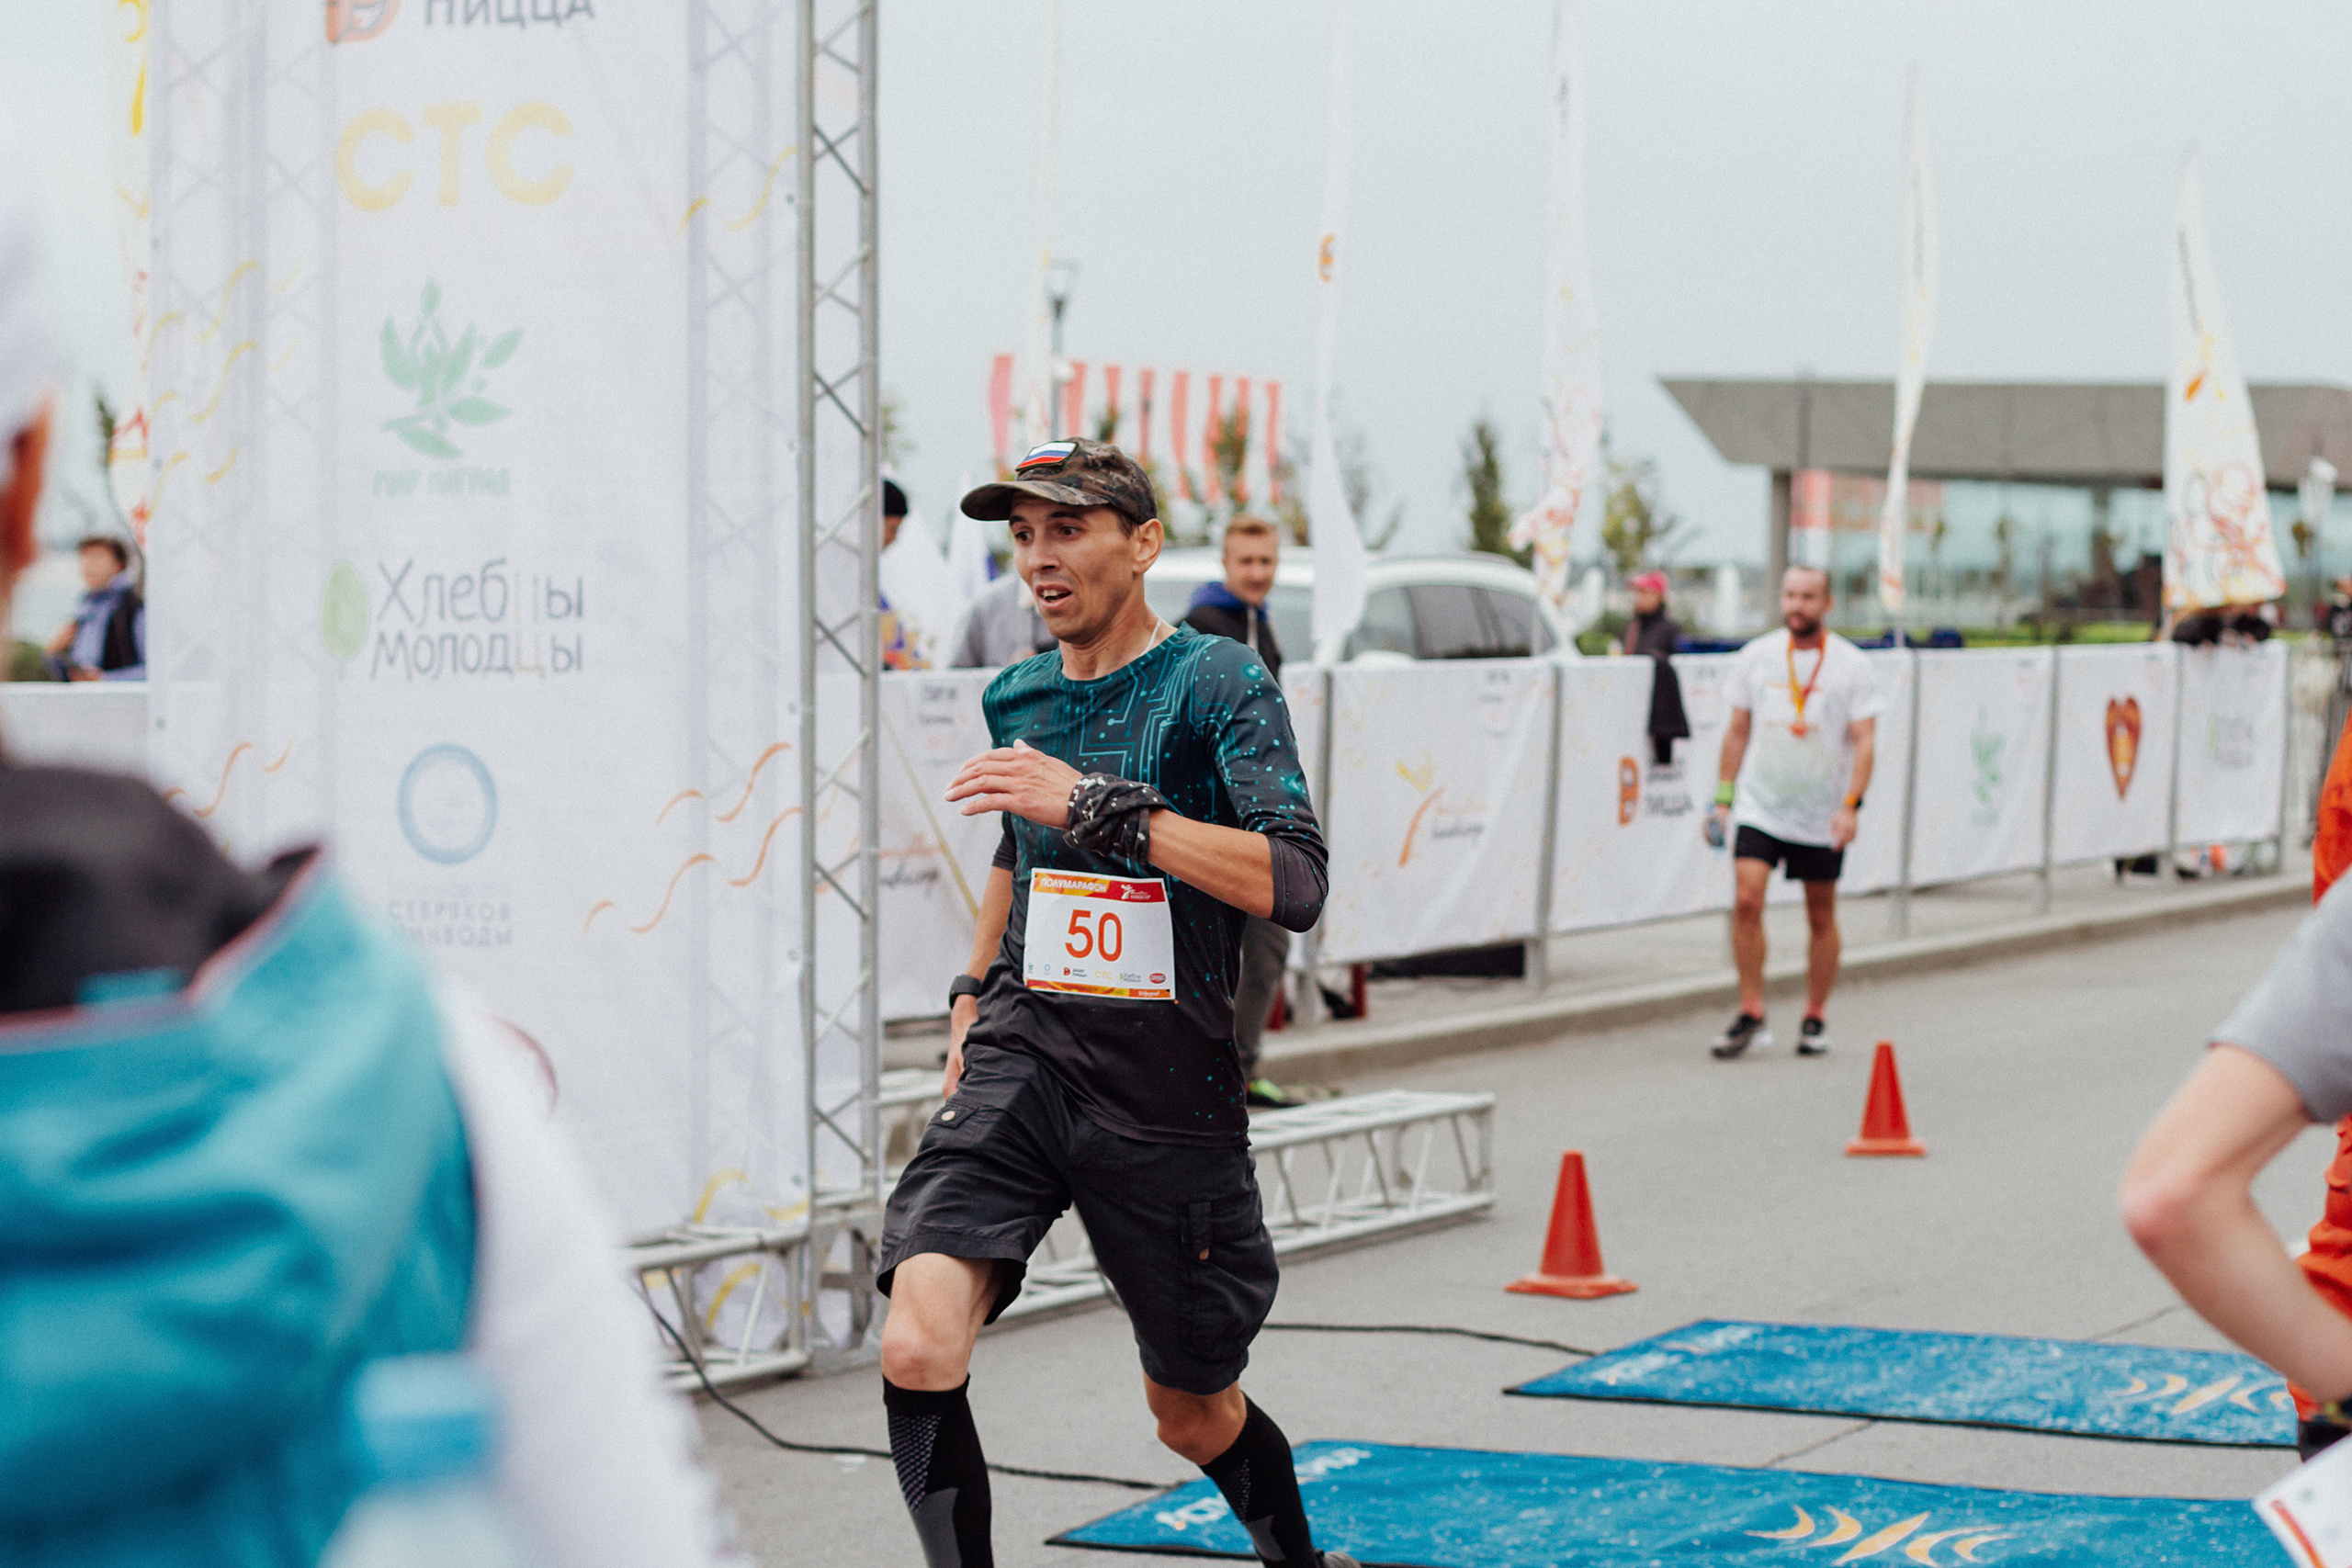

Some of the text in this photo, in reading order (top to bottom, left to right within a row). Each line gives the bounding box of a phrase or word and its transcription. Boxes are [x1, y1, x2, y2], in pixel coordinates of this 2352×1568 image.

[334, 102, 575, 211] СТС
[376, 558, 584, 627] Хлебцы
[1041, 877, 1106, 893] ПОЛУМАРАФОН
[1065, 909, 1122, 962] 50
